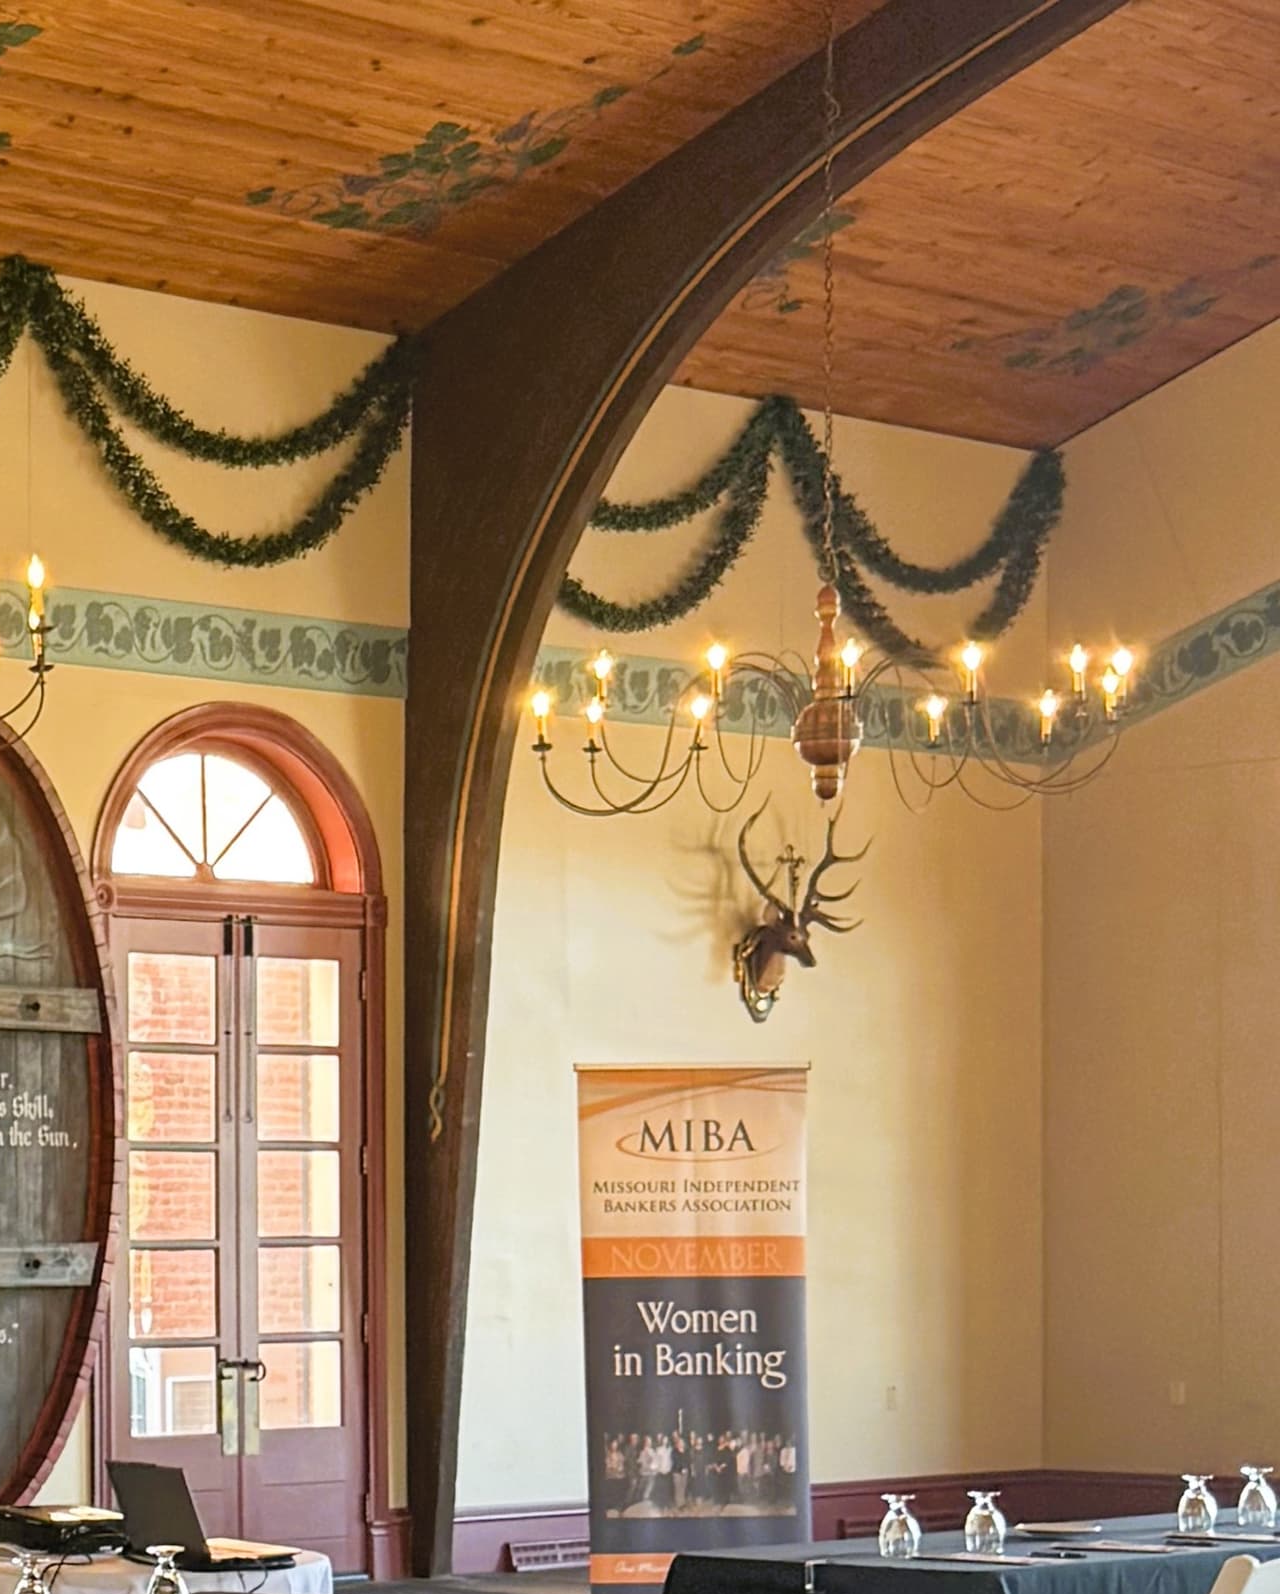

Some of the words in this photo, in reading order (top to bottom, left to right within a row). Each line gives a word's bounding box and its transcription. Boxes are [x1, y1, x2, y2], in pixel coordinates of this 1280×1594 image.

[9, 1120, 32, 1146] the
[640, 1119, 758, 1152] MIBA
[593, 1181, 676, 1194] MISSOURI
[683, 1179, 801, 1193] INDEPENDENT
[604, 1199, 677, 1213] BANKERS
[681, 1198, 792, 1213] ASSOCIATION
[611, 1242, 783, 1272] NOVEMBER
[637, 1301, 758, 1335] Women
[614, 1344, 643, 1376] in
[656, 1341, 788, 1389] Banking
